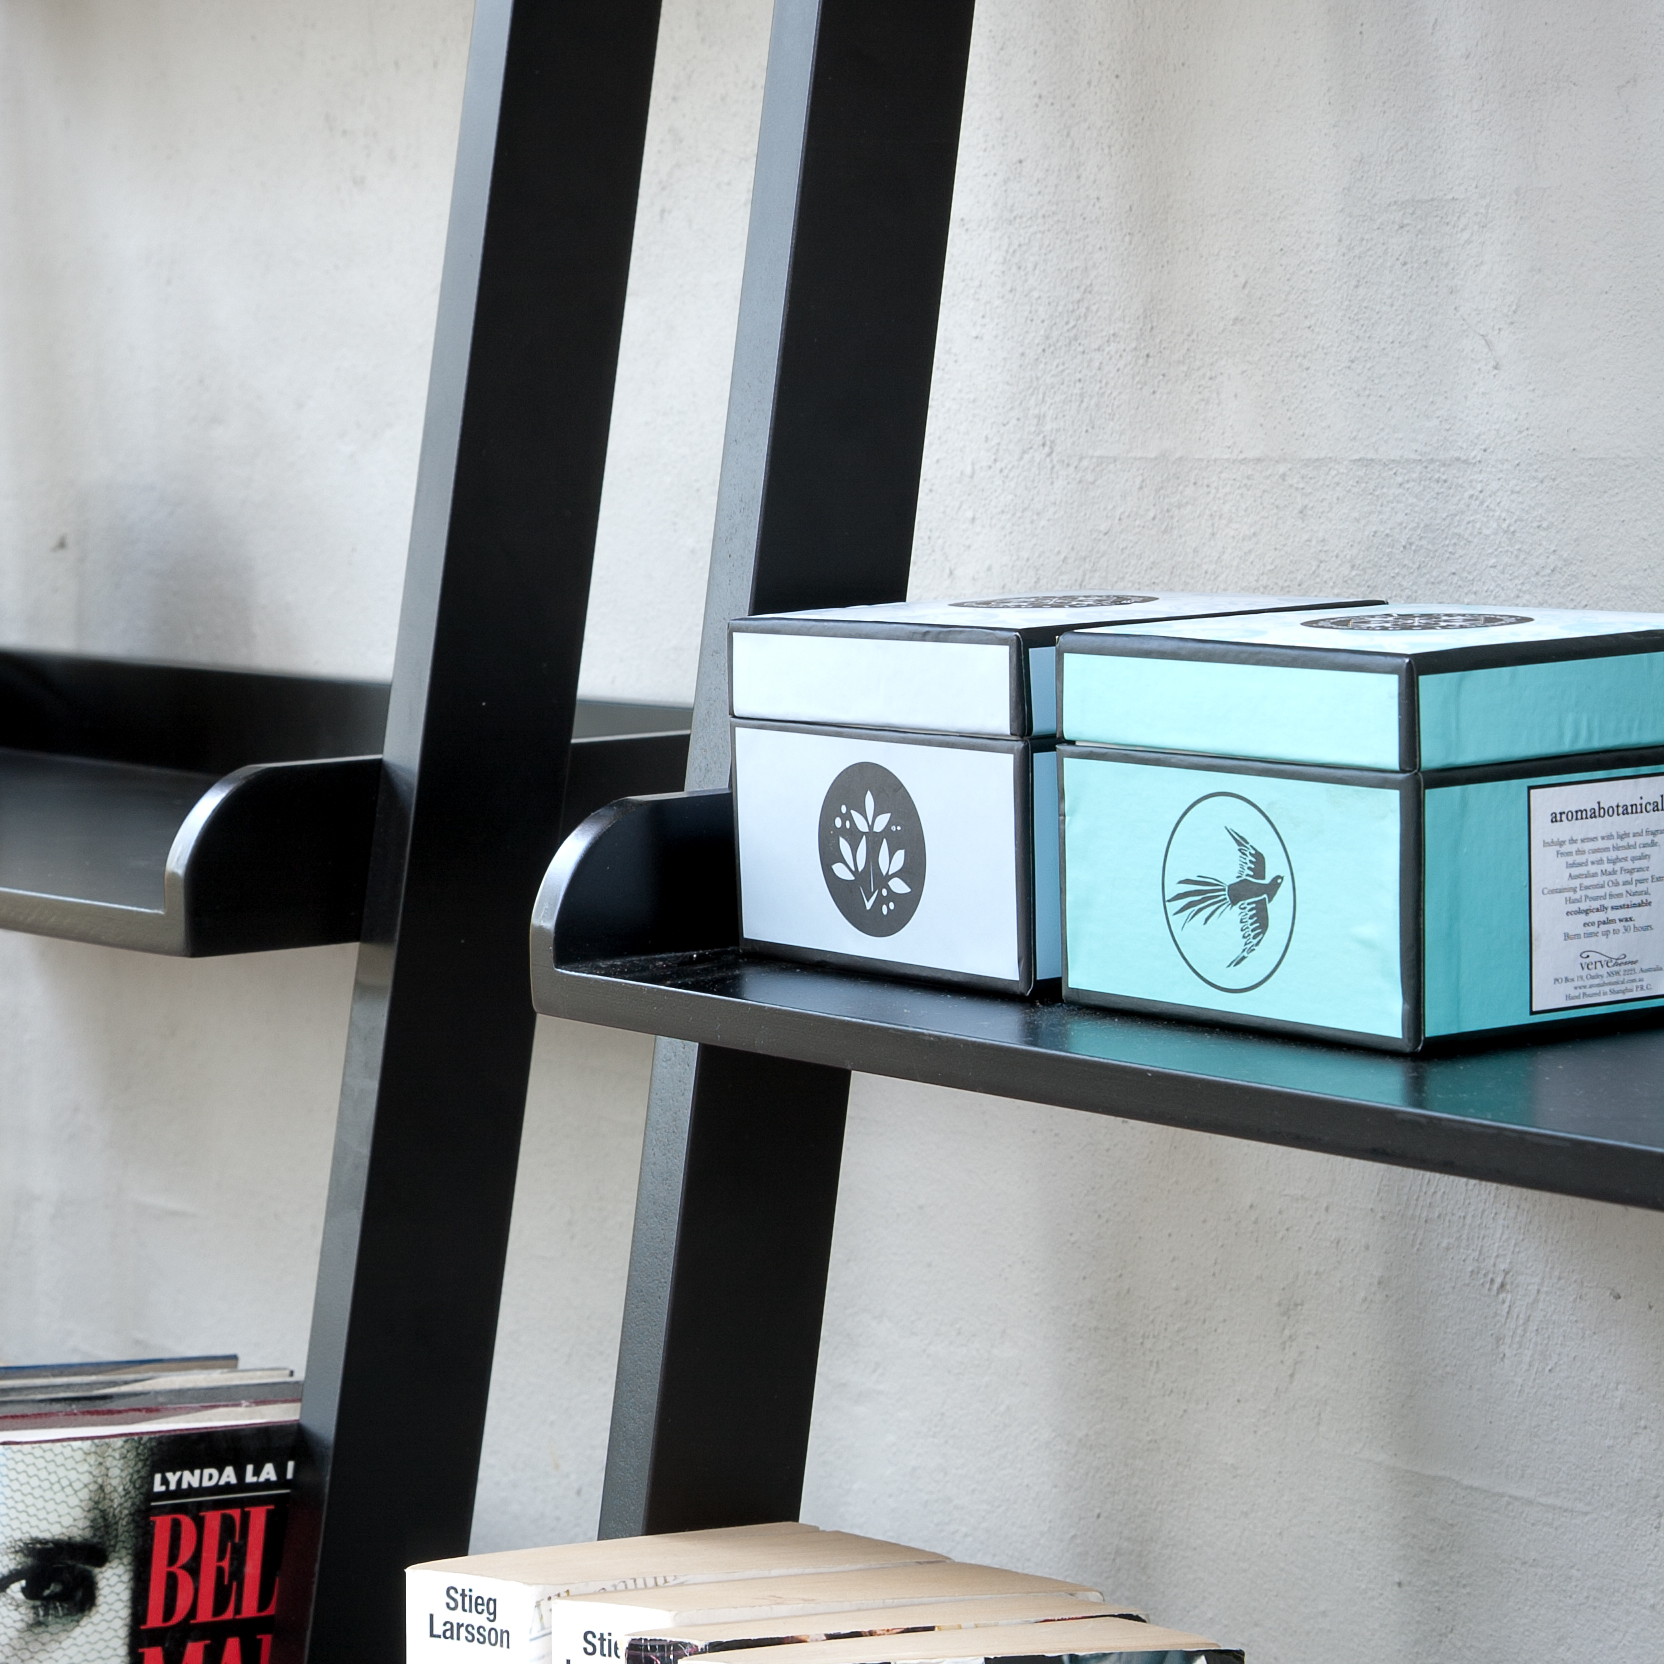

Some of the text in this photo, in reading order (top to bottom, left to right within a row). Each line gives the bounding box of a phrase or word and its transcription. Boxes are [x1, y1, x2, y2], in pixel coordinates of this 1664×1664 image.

[1550, 794, 1664, 824] aromabotanical
[1542, 838, 1567, 849] Indulge
[1568, 836, 1579, 846] the
[1580, 836, 1599, 844] senses
[1601, 832, 1615, 841] with
[1617, 830, 1631, 841] light
[1632, 829, 1644, 838] and
[1556, 849, 1574, 859] From
[1575, 847, 1587, 857] this
[1588, 845, 1611, 855] custom
[1612, 841, 1637, 852] blended
[1565, 852, 1652, 869] Infused with highest quality
[1567, 865, 1650, 881] Australian Made Fragrance
[1541, 885, 1578, 896] Containing
[1579, 881, 1606, 891] Essential
[1607, 879, 1621, 888] Oils
[1622, 877, 1633, 886] and
[1634, 877, 1649, 888] pure
[1564, 894, 1583, 905] Hand
[1584, 892, 1607, 903] Poured
[1608, 890, 1624, 900] from
[1565, 899, 1653, 917] ecologically sustainable
[1582, 920, 1596, 929] eco
[1597, 916, 1617, 929] palm
[1563, 931, 1582, 942] Burn
[1583, 930, 1600, 939] time
[1601, 929, 1611, 939] up
[1612, 928, 1621, 936] to
[1622, 925, 1632, 935] 30
[1553, 976, 1564, 985] PO
[1564, 976, 1575, 984] Box
[1639, 965, 1664, 975] Australia
[1565, 992, 1582, 1002] Hand
[1582, 989, 1602, 1000] Poured
[1602, 989, 1608, 997] in
[153, 1465, 238, 1493] LYNDA
[244, 1462, 278, 1484] LA
[140, 1504, 280, 1630] BEL
[445, 1585, 498, 1623] Stieg
[428, 1612, 511, 1649] Larsson
